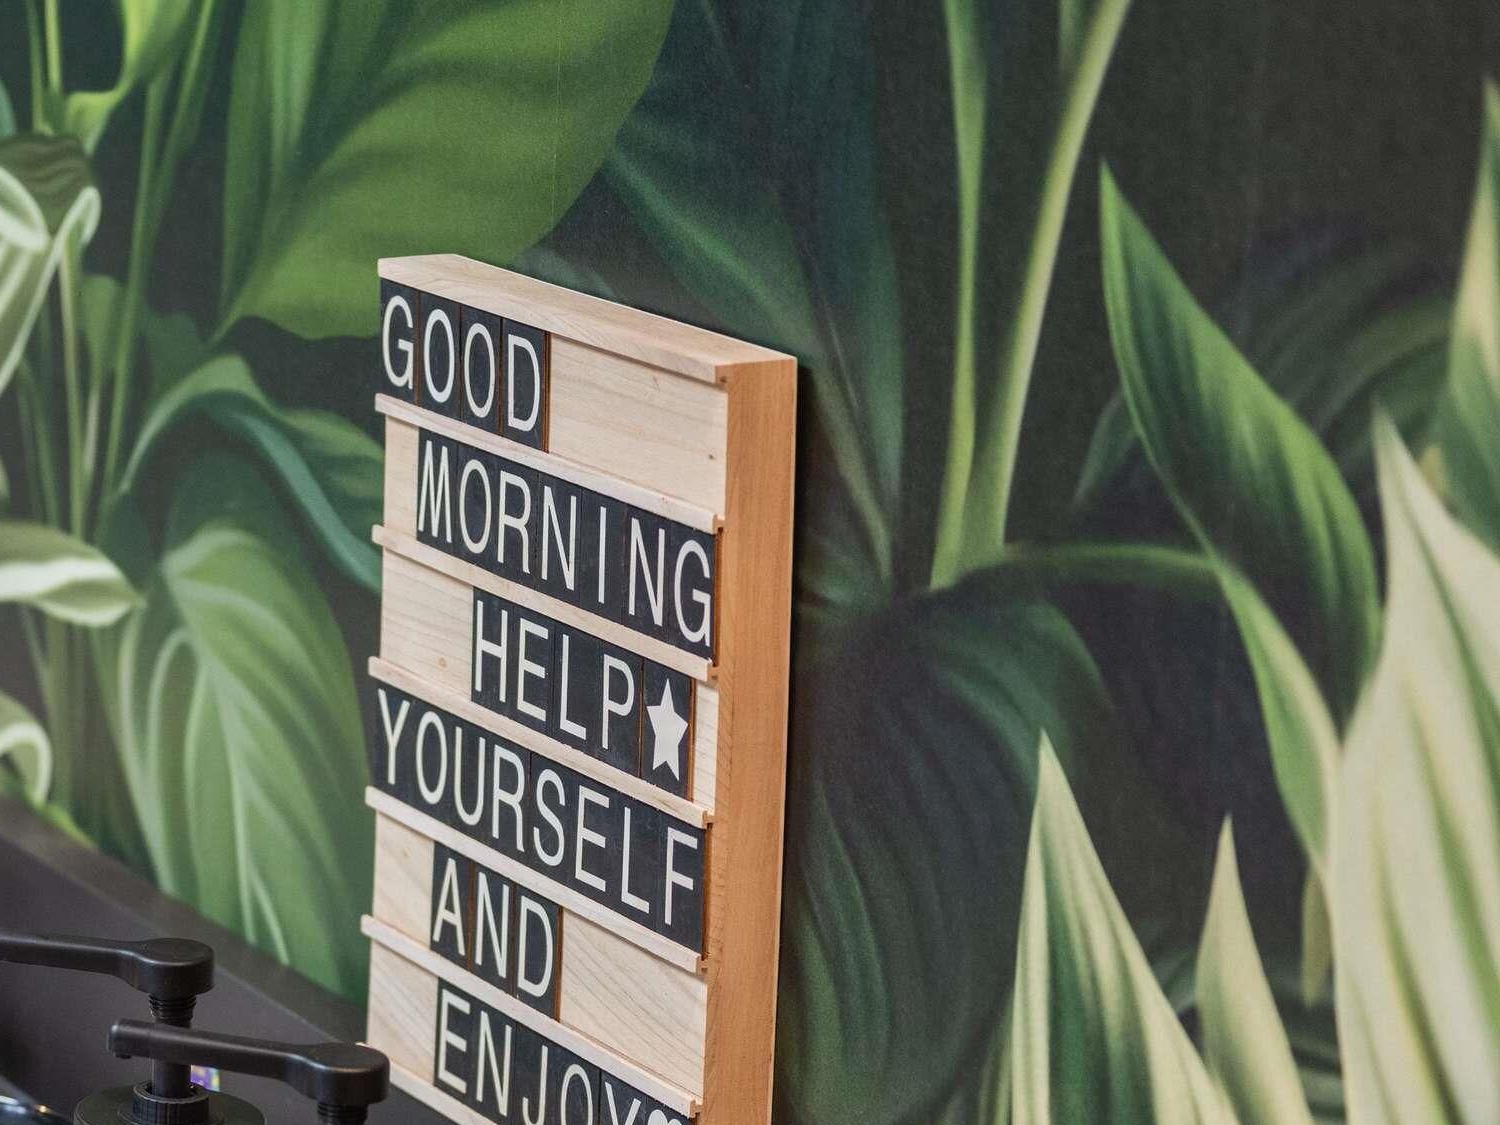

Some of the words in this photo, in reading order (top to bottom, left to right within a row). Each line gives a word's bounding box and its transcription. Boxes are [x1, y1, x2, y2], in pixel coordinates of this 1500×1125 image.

[381, 295, 541, 432] GOOD
[418, 440, 712, 647] MORNING
[474, 599, 635, 750] HELP
[378, 688, 698, 926] YOURSELF
[432, 857, 555, 998] AND
